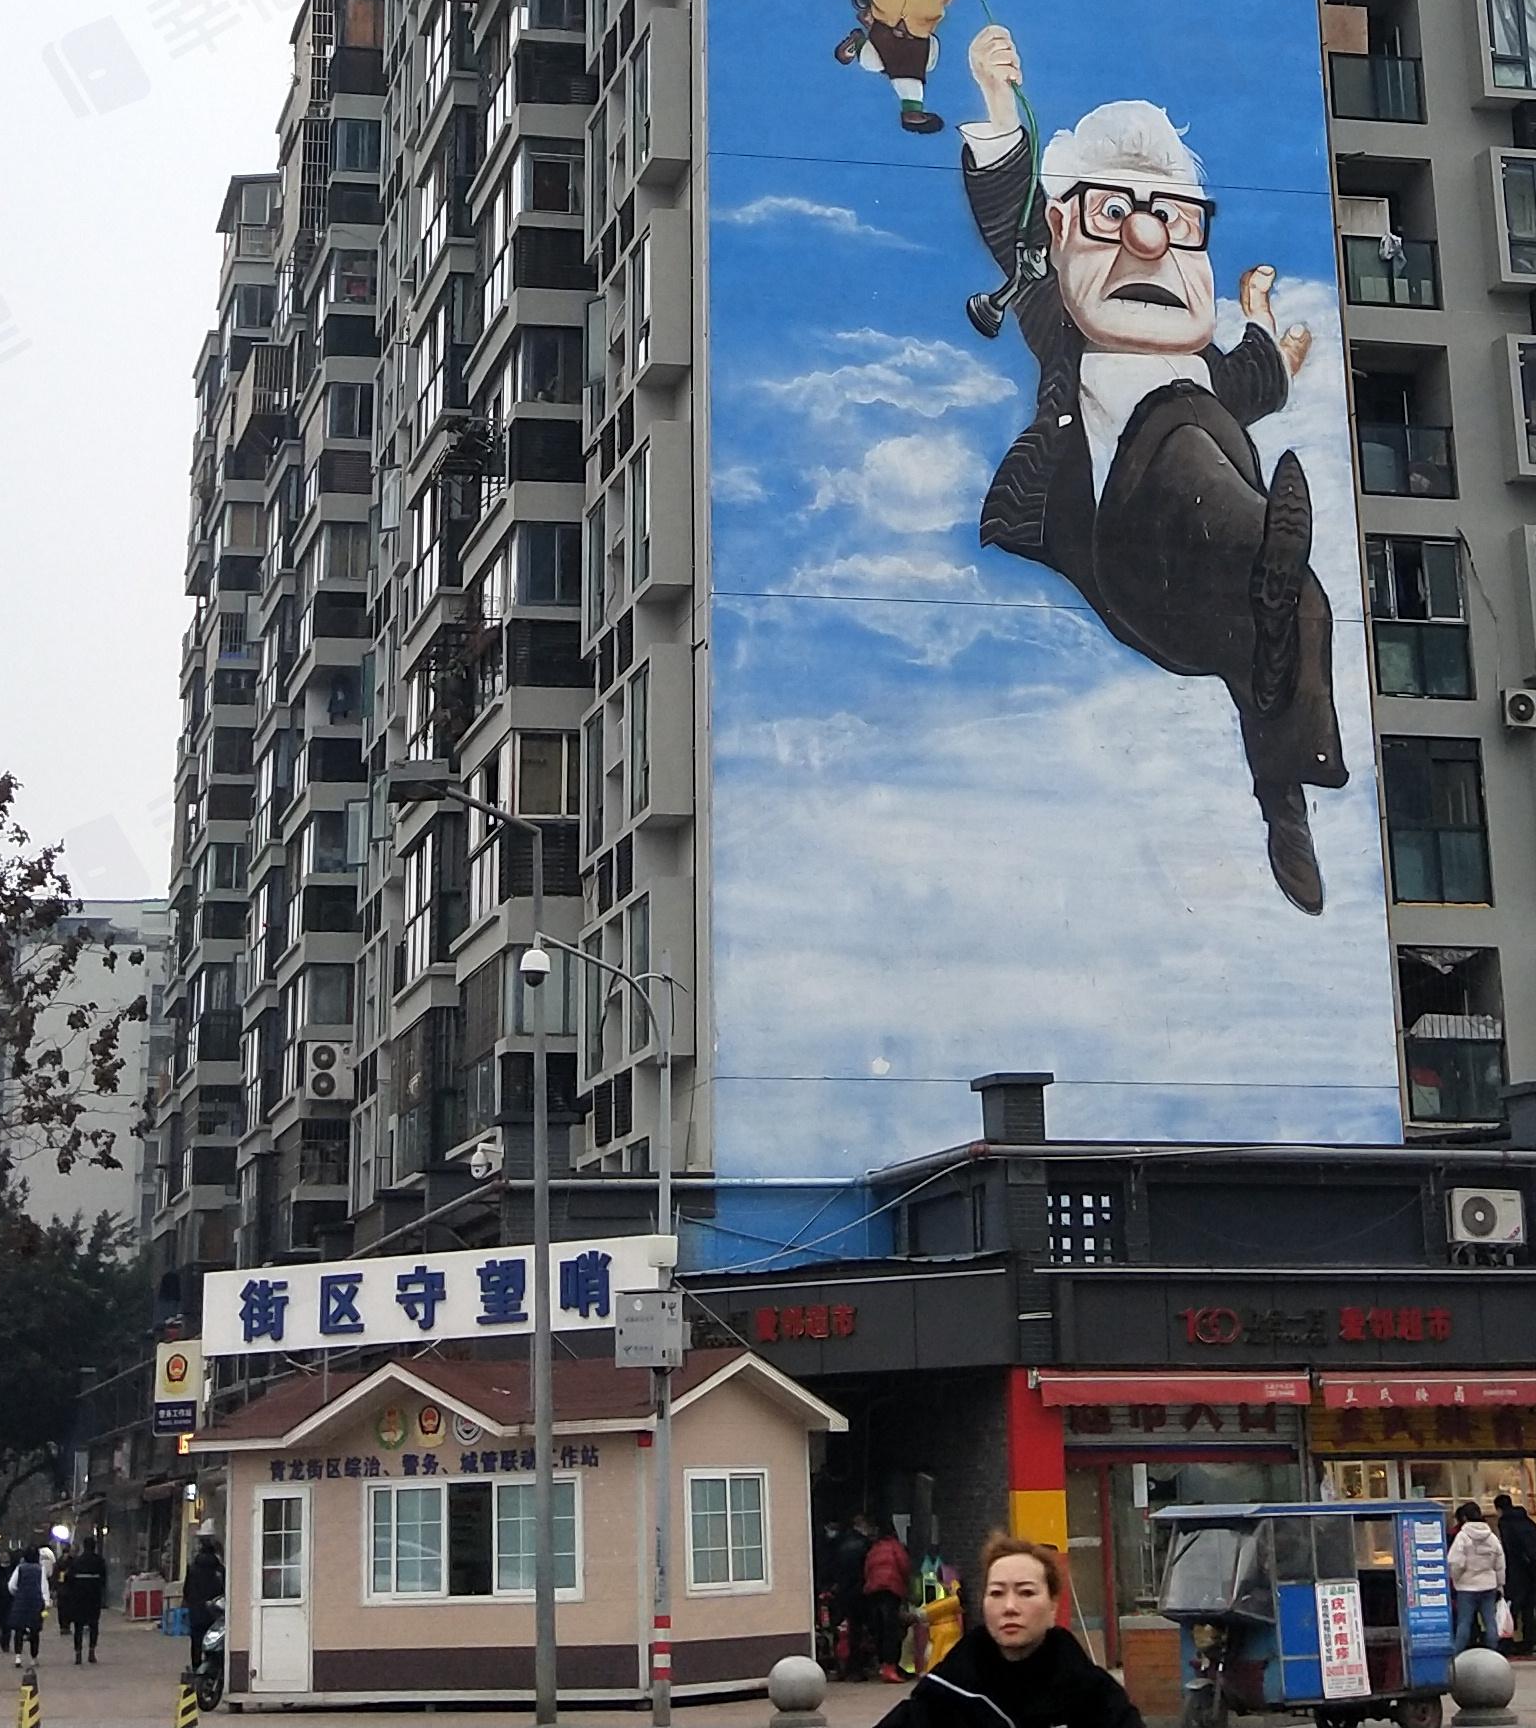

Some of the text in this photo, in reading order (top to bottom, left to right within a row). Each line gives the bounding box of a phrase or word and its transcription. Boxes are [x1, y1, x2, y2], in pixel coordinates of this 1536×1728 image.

[239, 1250, 612, 1342] 街区守望哨
